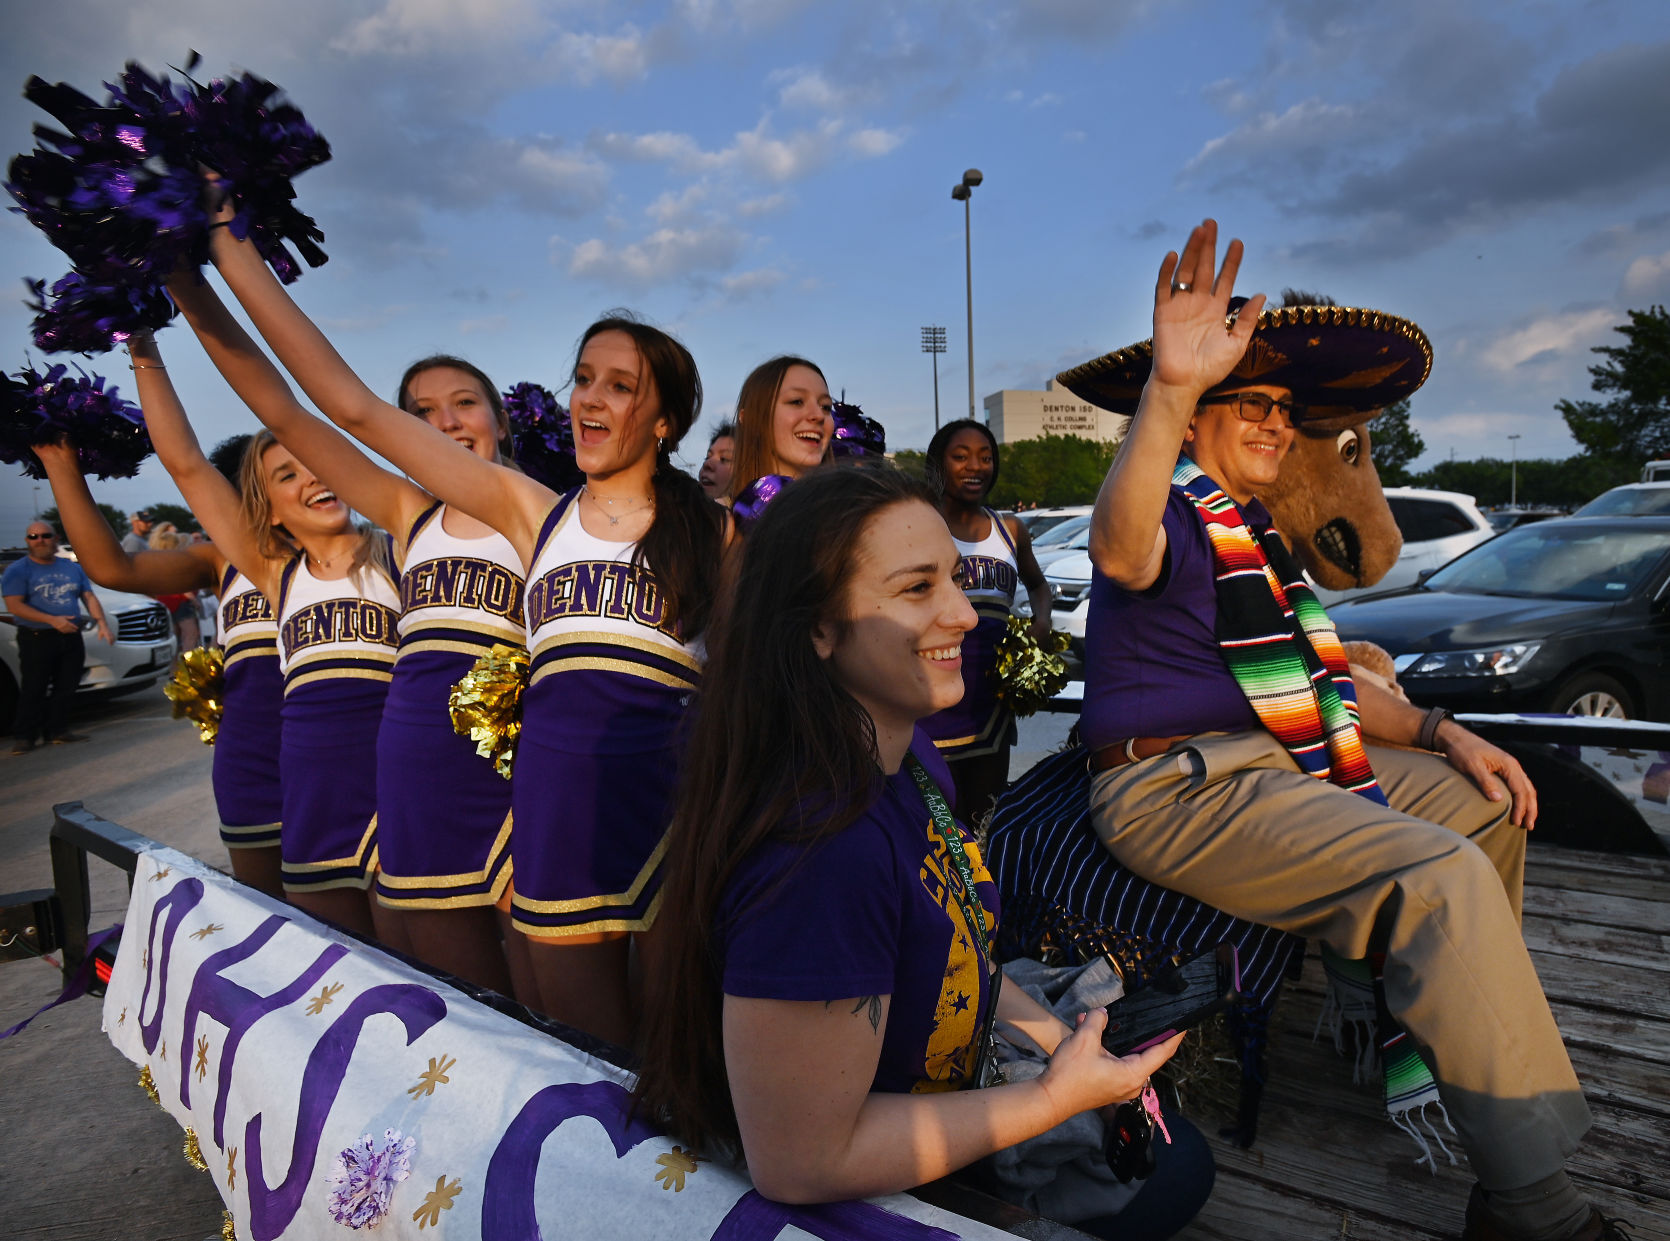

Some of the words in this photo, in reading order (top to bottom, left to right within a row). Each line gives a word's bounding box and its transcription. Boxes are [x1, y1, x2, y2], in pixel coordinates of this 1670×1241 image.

[1043, 404, 1076, 413] DENTON
[1079, 404, 1093, 413] ISD
[528, 560, 684, 646] DENTO
[948, 835, 963, 854] 123
